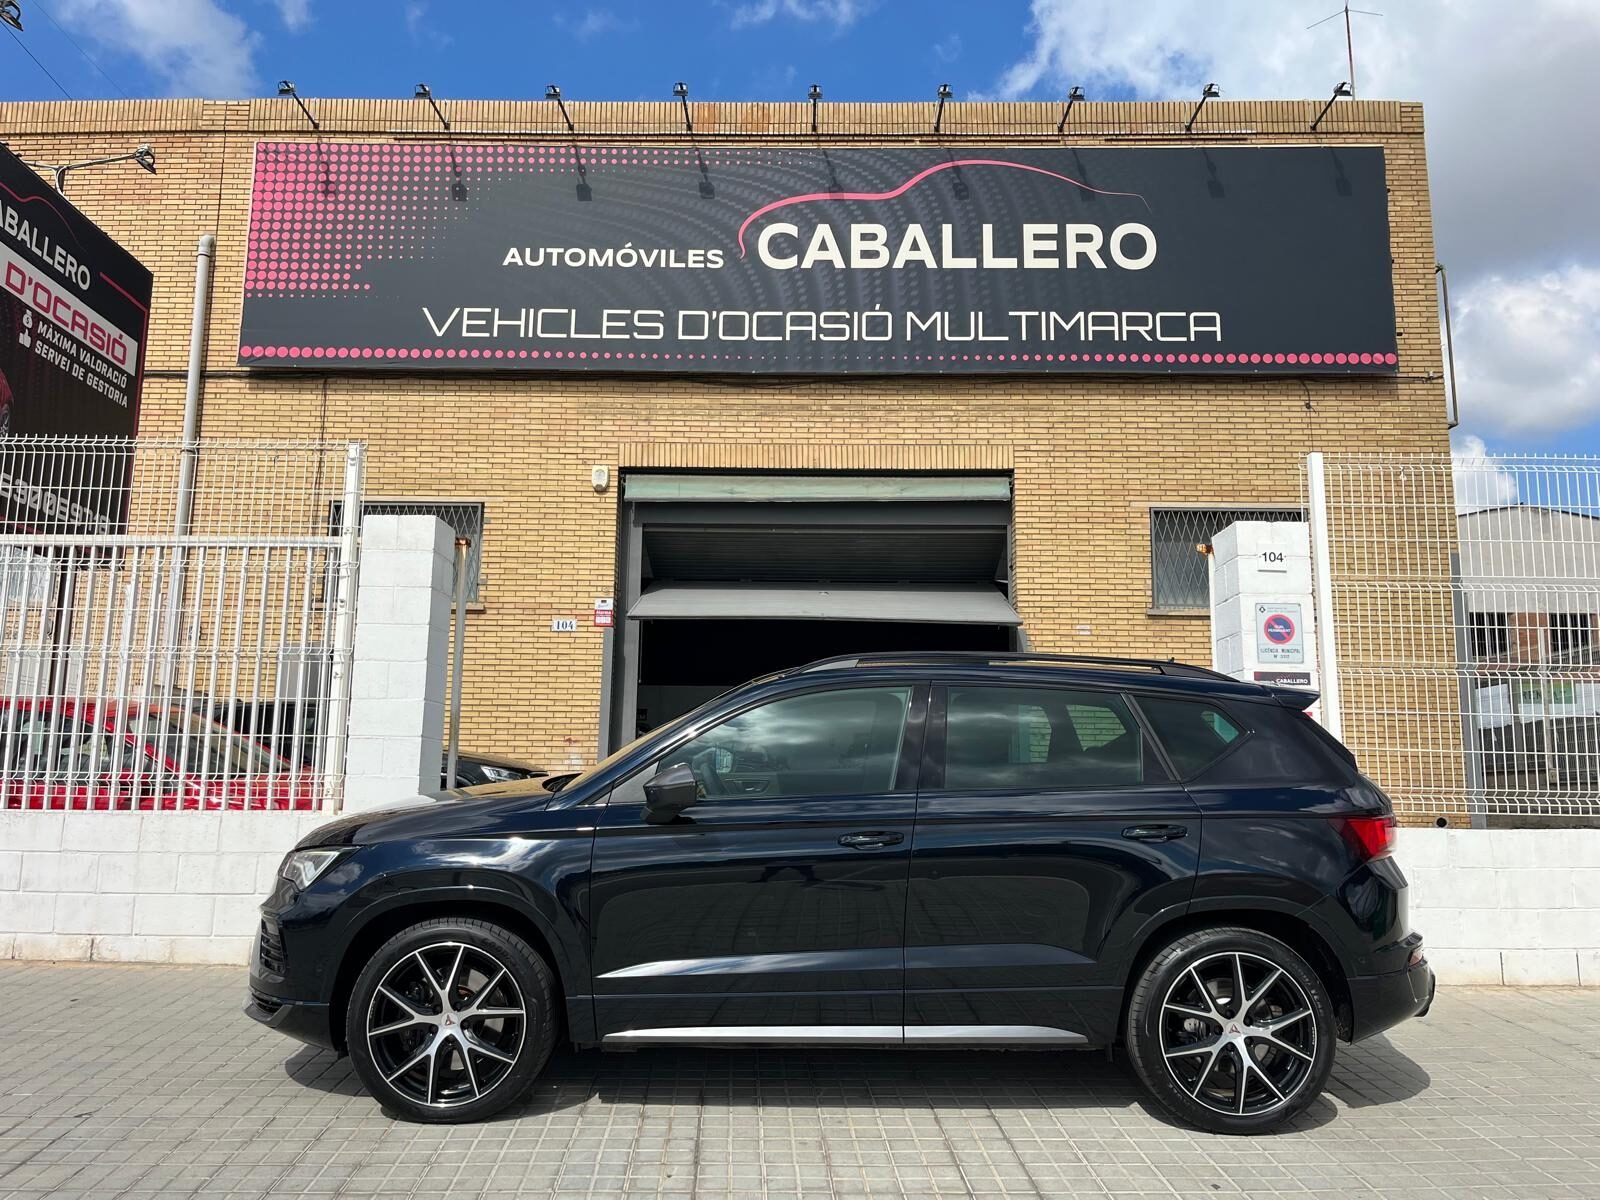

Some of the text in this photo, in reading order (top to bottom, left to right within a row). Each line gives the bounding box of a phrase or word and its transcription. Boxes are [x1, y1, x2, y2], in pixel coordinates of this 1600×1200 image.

[0, 203, 91, 290] BALLERO
[502, 222, 1157, 270] AUTOMÓVILES CABALLERO
[5, 261, 127, 366] D'OCASIÓ
[422, 303, 1222, 342] VEHICLES D'OCASIÓ MULTIMARCA
[34, 340, 128, 409] SERVEI DE GESTORIA
[37, 320, 128, 389] MÀXIMA VALORACIÓ
[1261, 552, 1284, 563] 104
[556, 620, 574, 630] 104
